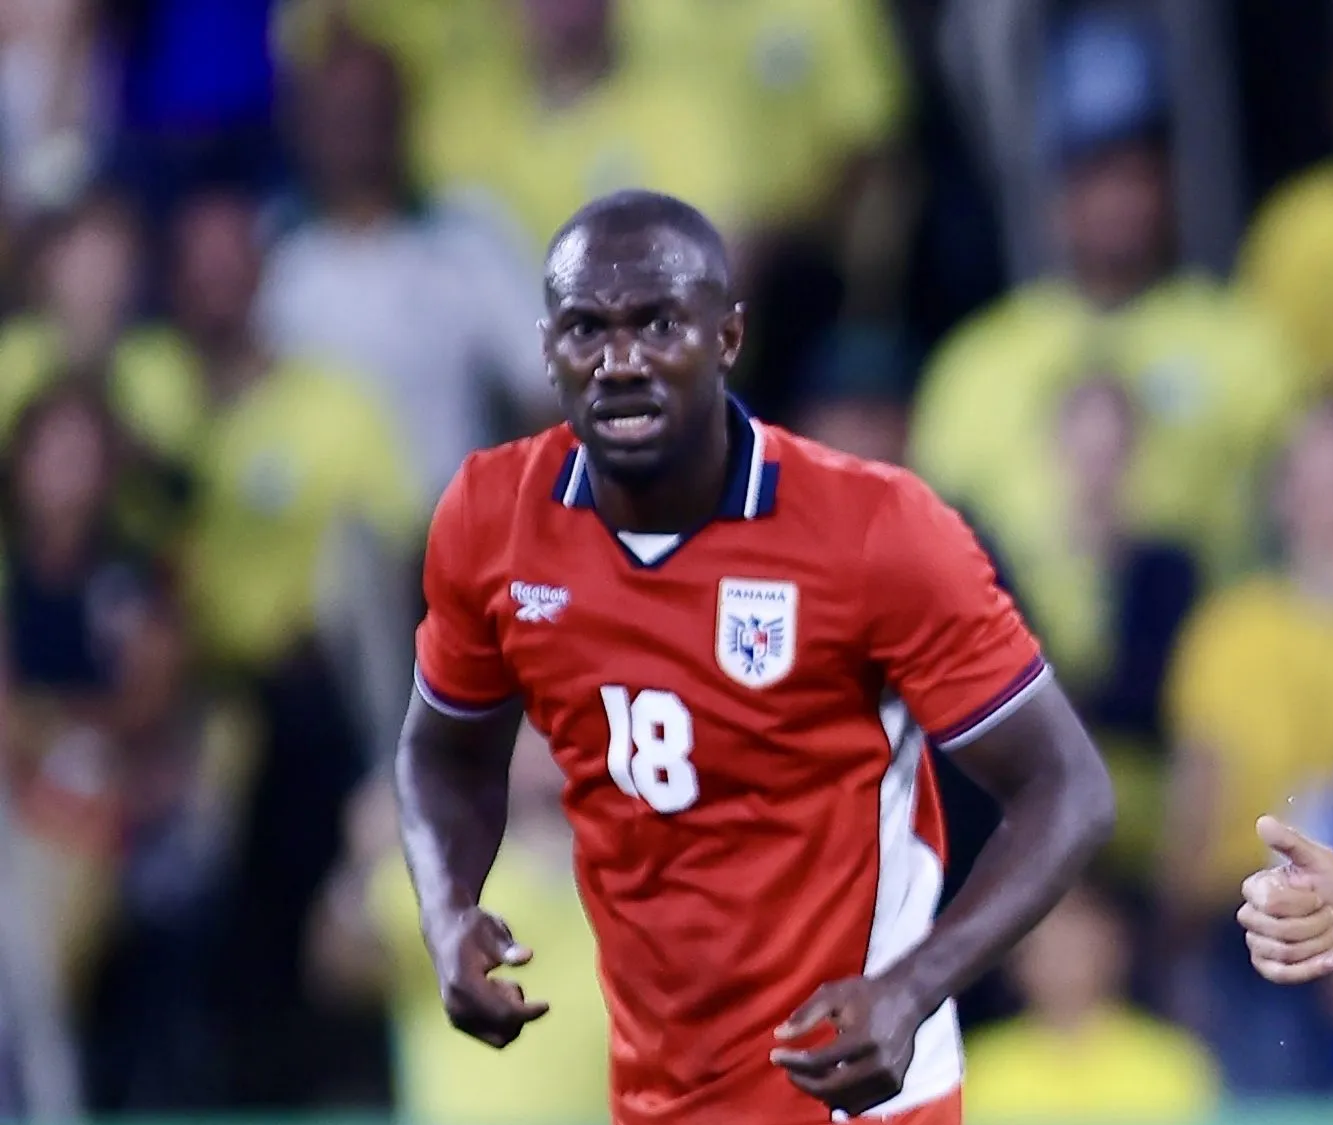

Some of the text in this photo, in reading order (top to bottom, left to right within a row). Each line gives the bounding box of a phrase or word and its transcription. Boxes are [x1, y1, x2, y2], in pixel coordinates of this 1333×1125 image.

[510, 581, 568, 604] Reebok
[726, 586, 788, 602] PANAMÁ
[600, 684, 700, 814] 18
